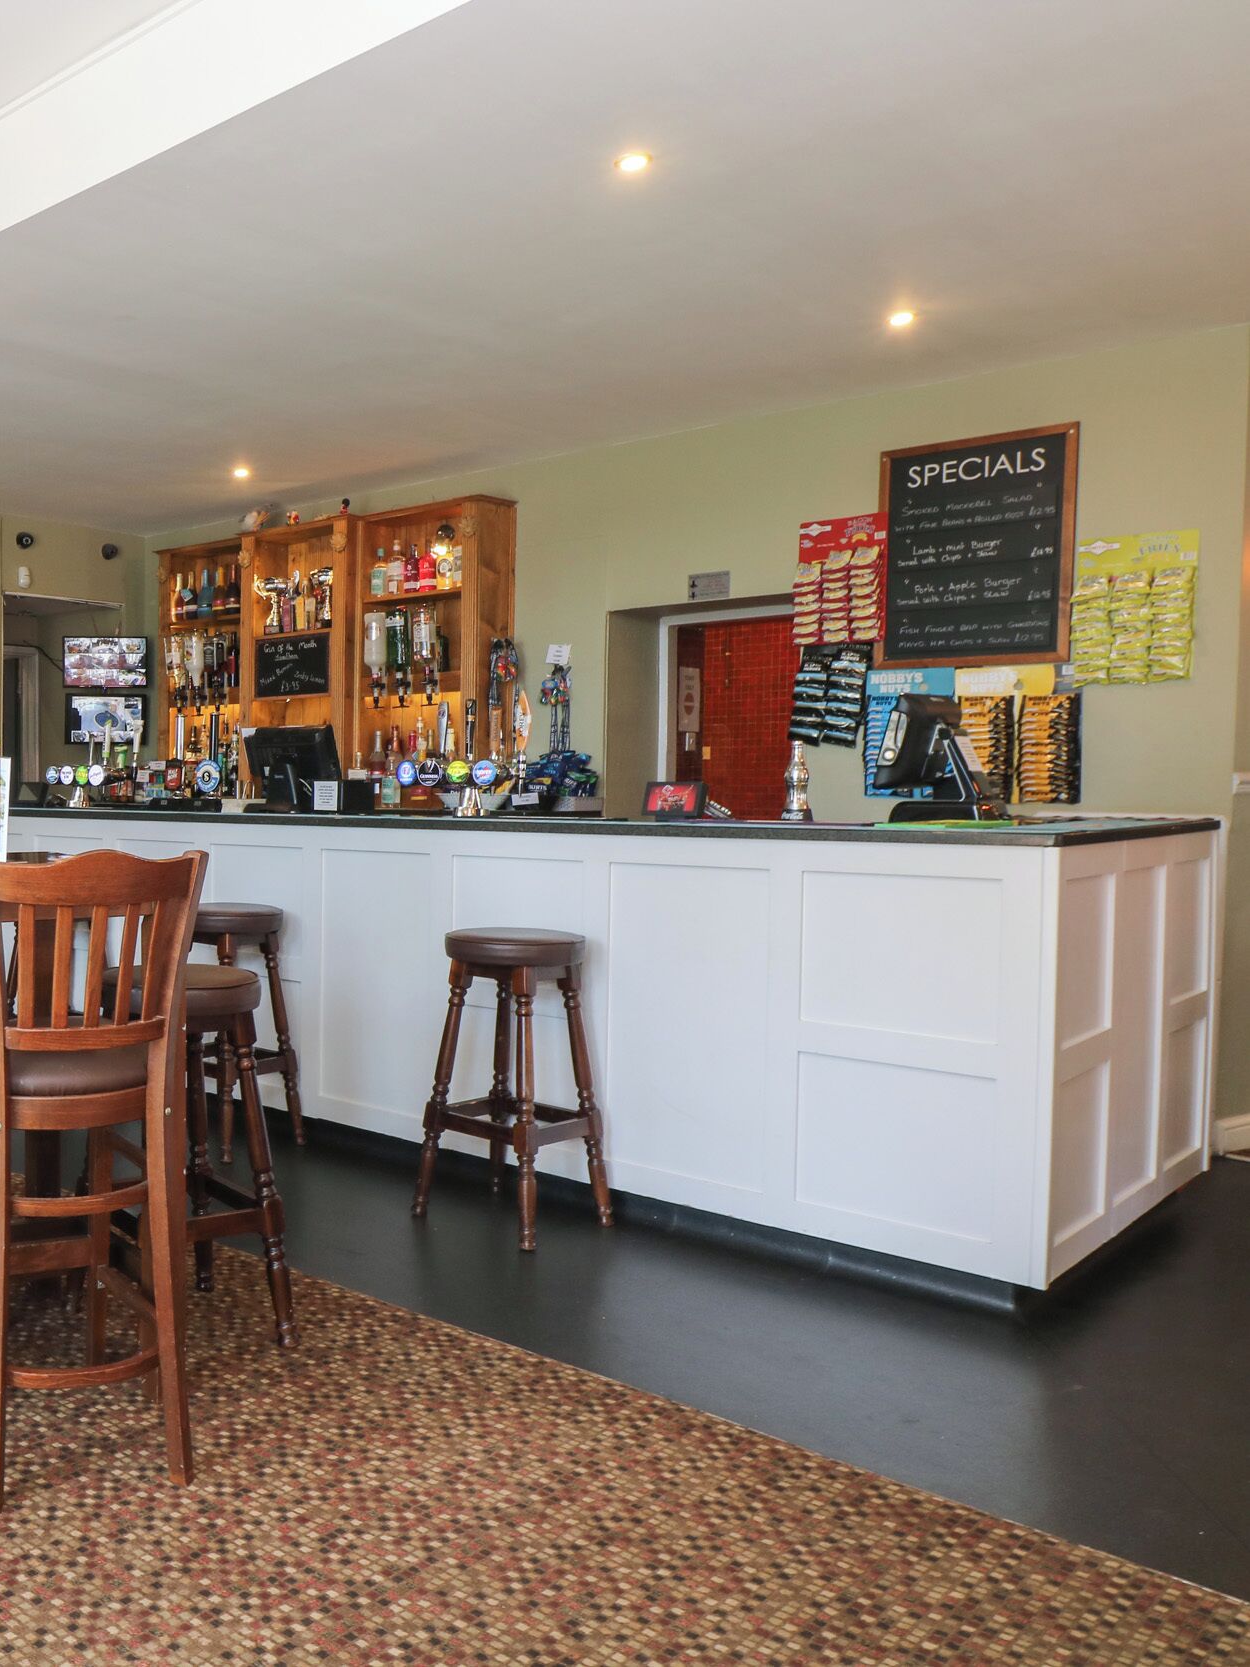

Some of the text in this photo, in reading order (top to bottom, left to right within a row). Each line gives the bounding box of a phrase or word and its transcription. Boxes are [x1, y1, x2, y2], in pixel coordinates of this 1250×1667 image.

[906, 447, 1046, 488] SPECIALS
[912, 546, 936, 555] Lamb
[971, 539, 1003, 552] Burger
[914, 584, 935, 594] Pork
[948, 581, 978, 593] Apple
[983, 577, 1022, 590] Burger
[924, 623, 956, 633] FINGER
[264, 644, 275, 653] Gin
[299, 640, 317, 650] Month
[870, 672, 924, 684] NOBBY'S
[880, 684, 911, 693] NUTS
